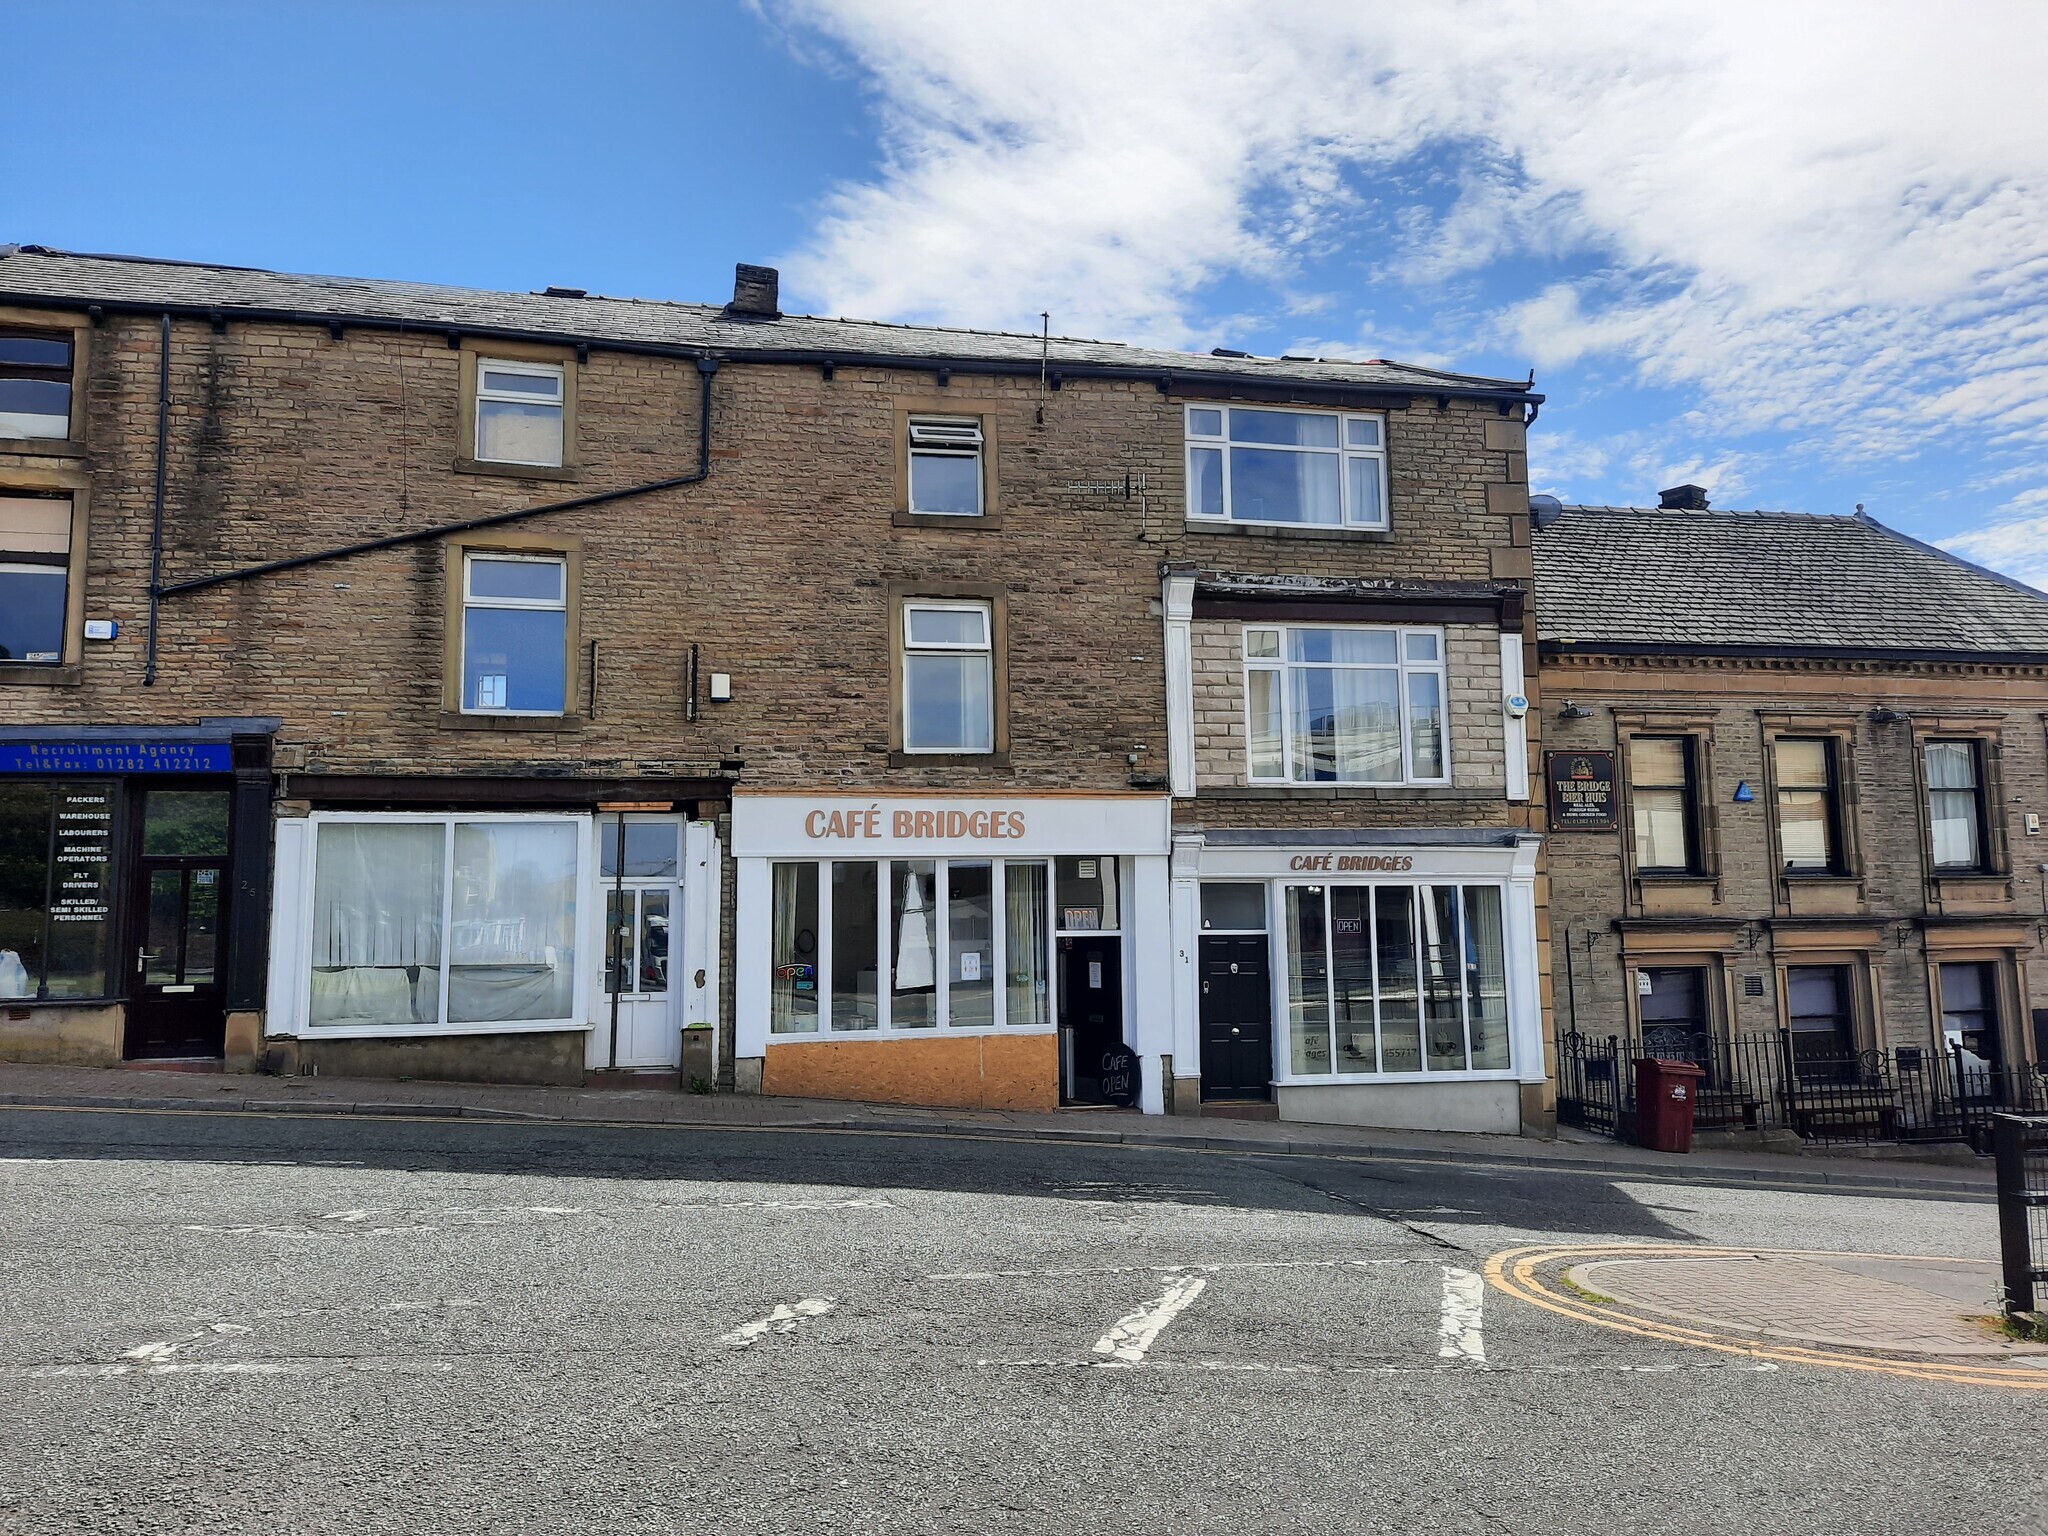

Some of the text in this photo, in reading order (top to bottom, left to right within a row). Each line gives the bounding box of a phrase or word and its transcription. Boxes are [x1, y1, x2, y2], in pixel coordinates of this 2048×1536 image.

[30, 744, 195, 758] Recruitment Agency
[15, 758, 211, 769] Tel&Fax: 01282 412212
[1556, 781, 1611, 792] THE BRIDGE
[1561, 792, 1607, 803] BIER HUIS
[805, 803, 1026, 839] CAFÉ BRIDGES
[1290, 852, 1413, 871] CAFÉ BRIDGES
[1065, 908, 1098, 930] OPEN
[1338, 920, 1359, 932] OPEN
[776, 966, 814, 981] open
[1102, 1052, 1129, 1071] CAFE
[1102, 1071, 1130, 1094] OPEN
